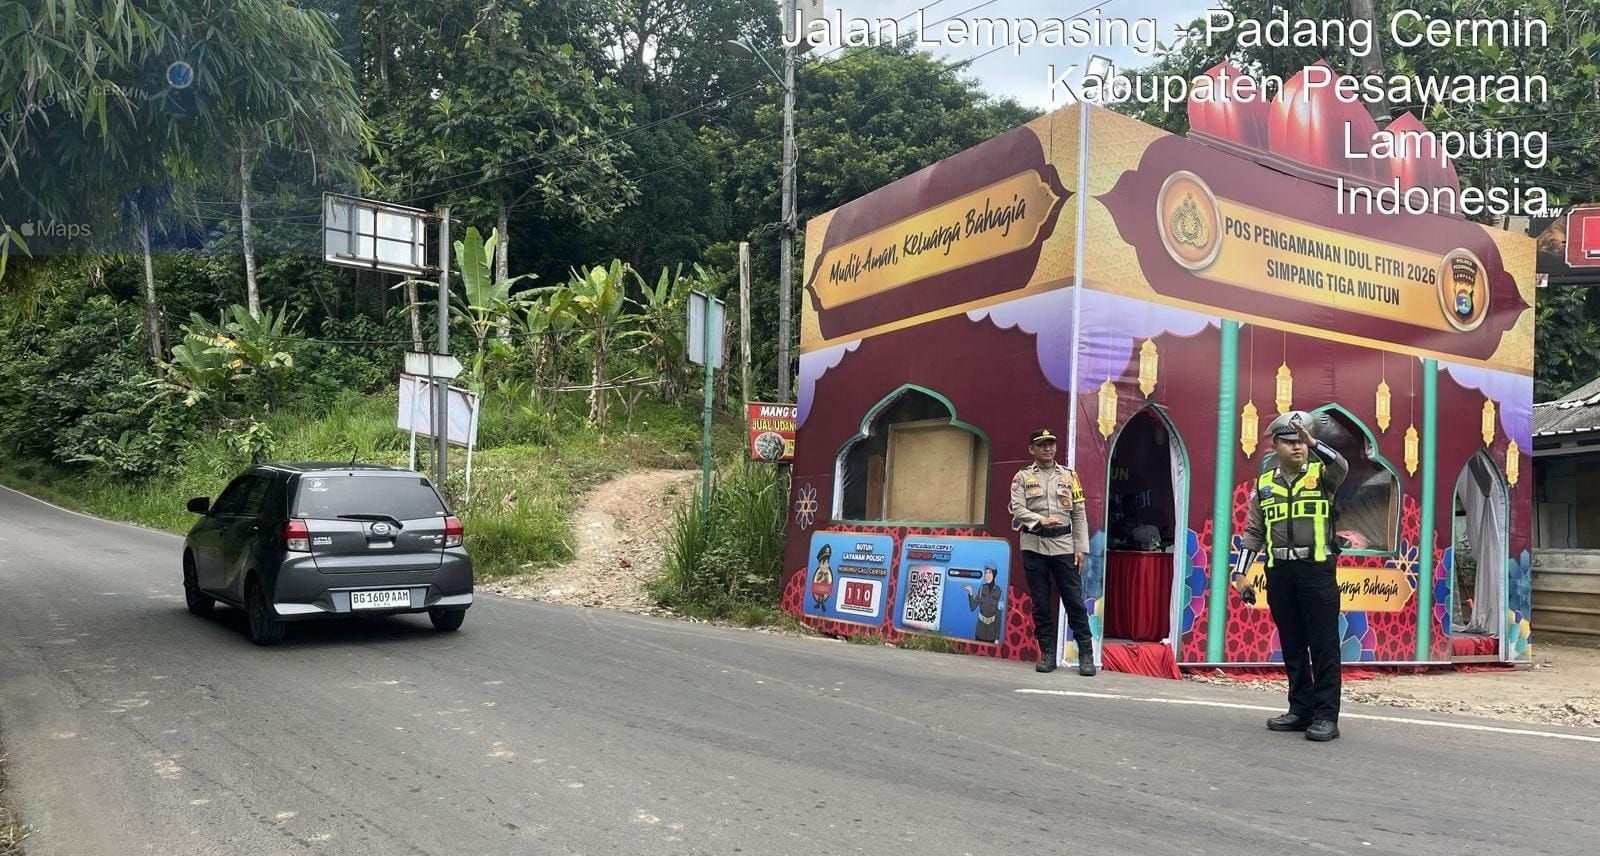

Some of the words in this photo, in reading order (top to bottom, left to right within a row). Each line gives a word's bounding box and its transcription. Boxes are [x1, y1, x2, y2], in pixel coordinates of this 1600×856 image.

[830, 253, 862, 286] Mudik
[903, 222, 961, 257] Keluarga
[965, 194, 1027, 238] Bahagia
[1225, 216, 1251, 241] POS
[1254, 225, 1341, 263] PENGAMANAN
[1344, 249, 1372, 272] IDUL
[1375, 256, 1405, 279] FITRI
[1408, 264, 1436, 286] 2026
[1267, 259, 1324, 289] SIMPANG
[1327, 273, 1354, 296] TIGA
[1358, 282, 1400, 306] MUTUN
[760, 406, 789, 418] MANG
[752, 420, 773, 431] JUAL
[353, 593, 365, 604] BG
[366, 591, 390, 603] 1609
[847, 587, 870, 601] 110
[1338, 581, 1361, 601] arga
[1363, 576, 1398, 602] Bahagia
